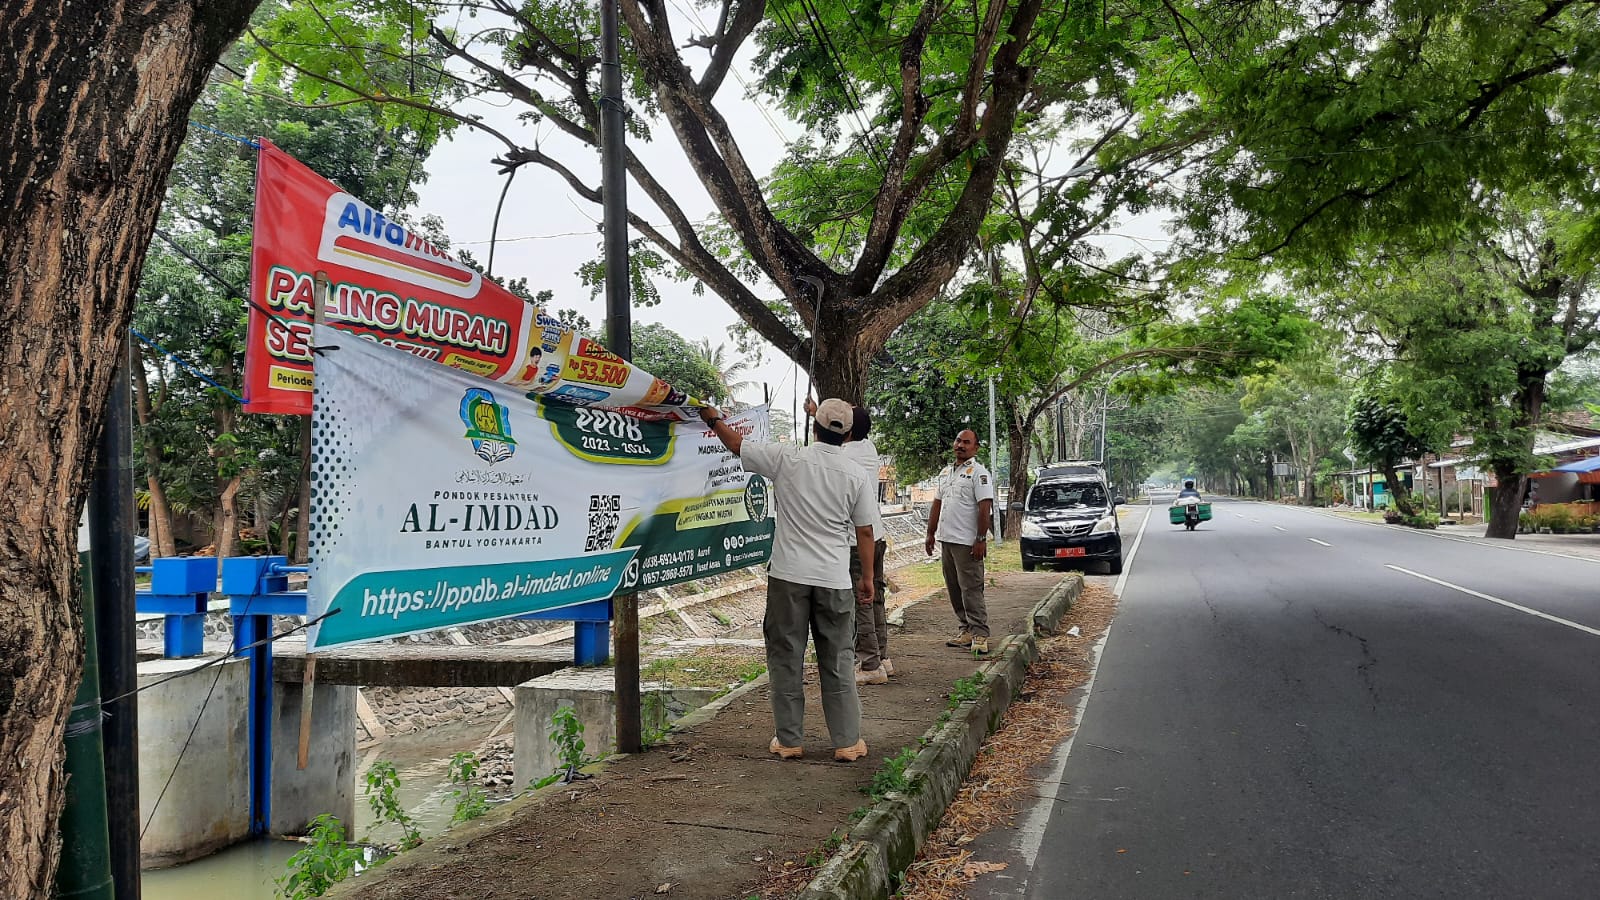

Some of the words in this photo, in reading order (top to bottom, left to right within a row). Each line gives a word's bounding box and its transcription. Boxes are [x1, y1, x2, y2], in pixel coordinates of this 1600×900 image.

[338, 201, 453, 263] Alfama
[270, 270, 399, 326] PALING
[406, 302, 506, 350] MURAH
[277, 372, 313, 387] Periode
[578, 359, 627, 385] 53.500
[582, 436, 611, 451] 2023
[622, 442, 652, 455] 2024
[433, 490, 481, 503] PONDOK
[483, 491, 540, 504] PESANTREN
[400, 503, 560, 533] AL-IMDAD
[426, 539, 473, 550] BANTUL
[476, 536, 542, 548] YOGYAKARTA
[361, 565, 612, 620] https://ppdb.al-imdad.online
